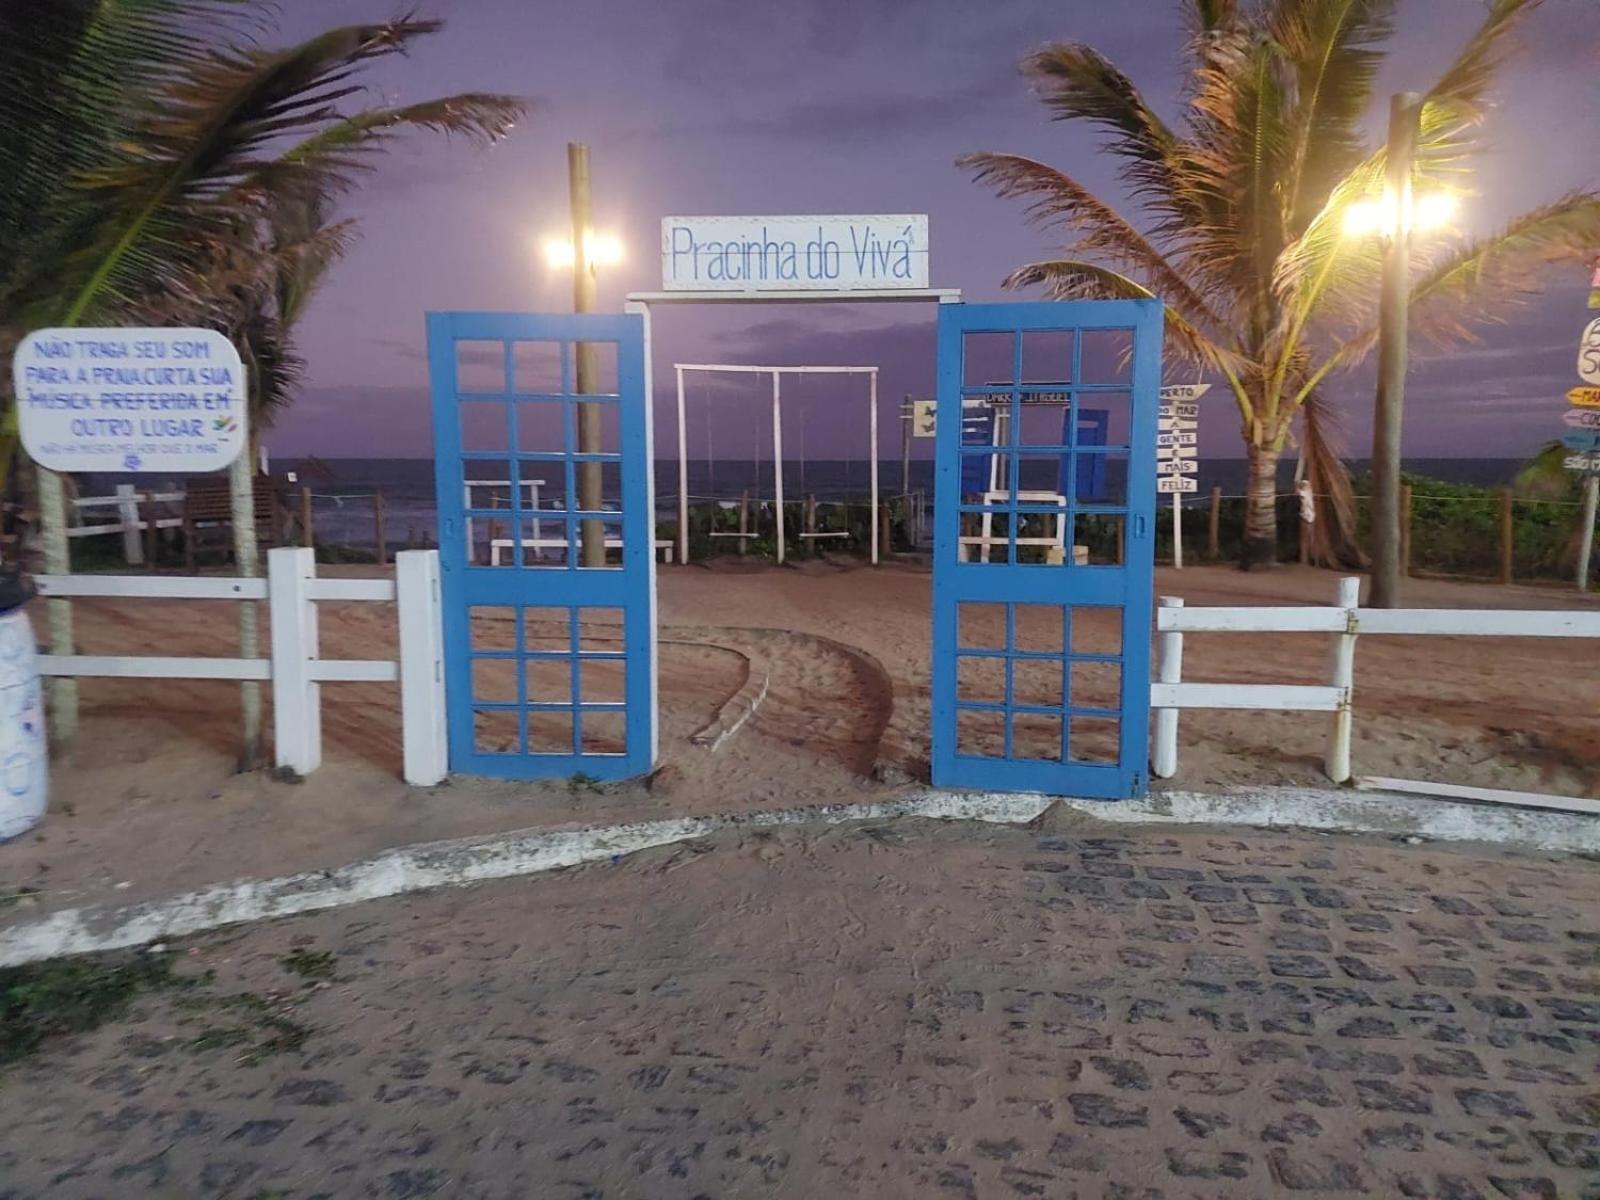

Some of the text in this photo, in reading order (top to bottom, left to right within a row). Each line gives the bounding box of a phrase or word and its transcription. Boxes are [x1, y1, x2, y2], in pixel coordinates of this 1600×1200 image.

[672, 224, 912, 280] Pracinha do Vivá
[34, 336, 210, 359] NÃO TRAGA SEU SOM
[26, 366, 71, 385] PARA
[76, 367, 89, 385] A
[200, 367, 233, 385] SUA
[100, 392, 199, 410] PREFERIDA
[203, 391, 231, 410] EM
[71, 418, 204, 437] OUTRO LUGAR
[1160, 435, 1192, 443] GENTE
[1165, 462, 1191, 471] MAIS
[1161, 479, 1192, 490] FELIZ
